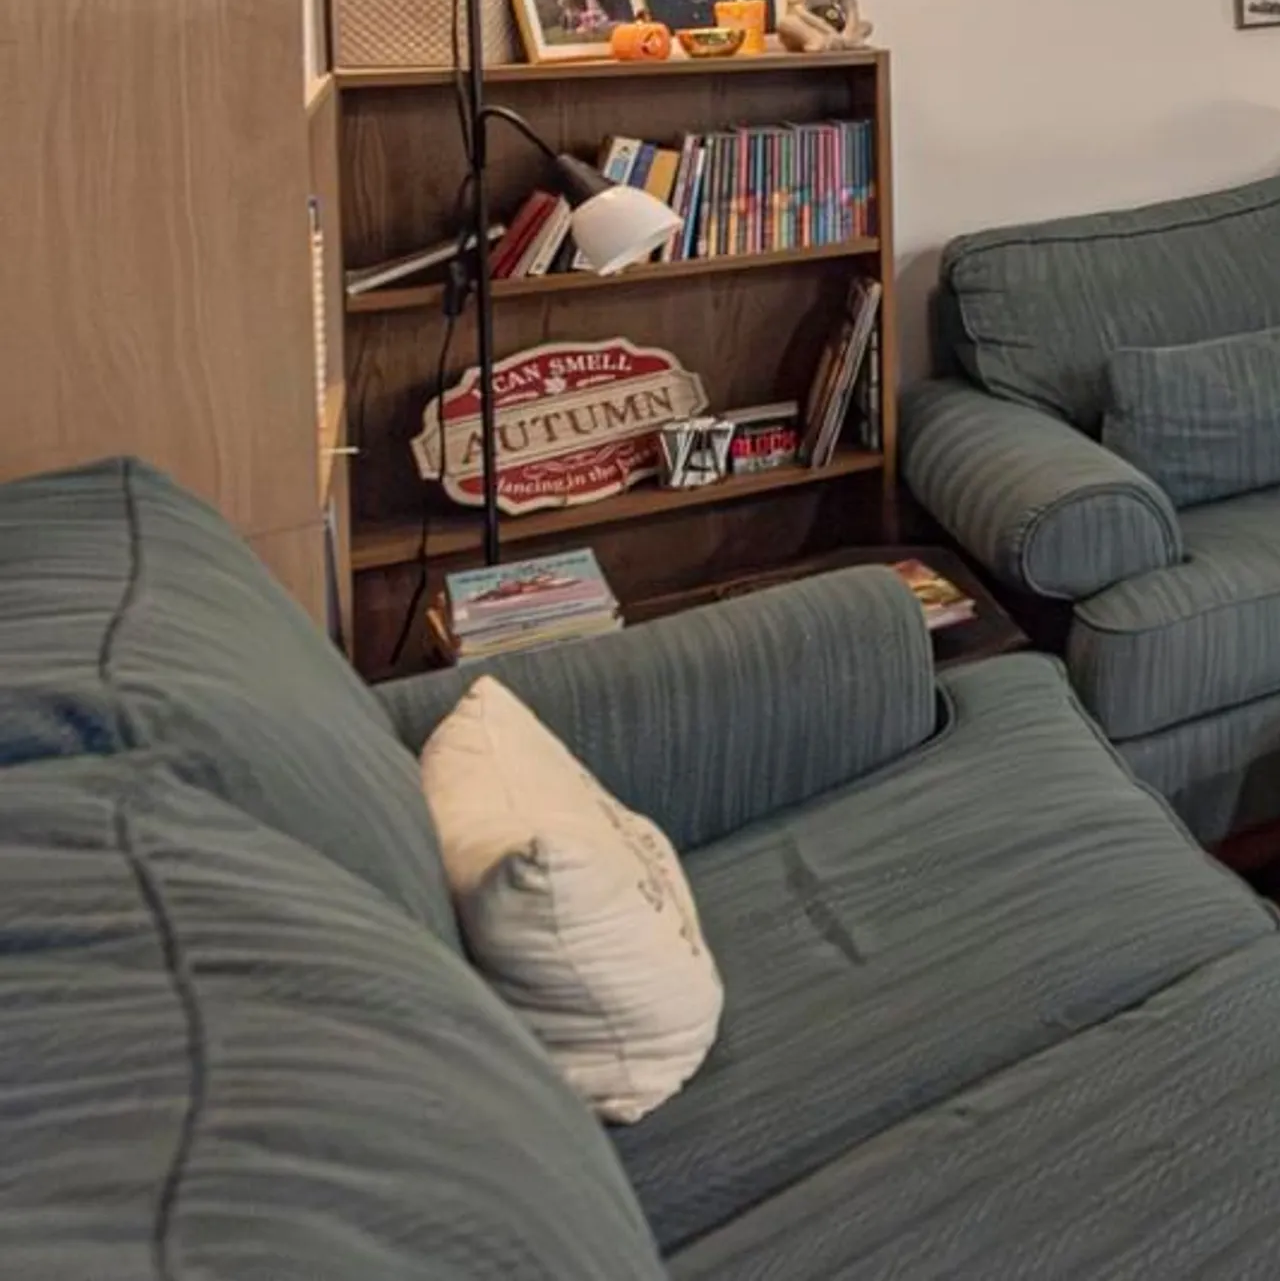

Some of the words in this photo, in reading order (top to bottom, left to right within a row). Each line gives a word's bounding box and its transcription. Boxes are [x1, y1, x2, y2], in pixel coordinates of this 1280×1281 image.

[492, 365, 539, 394] CAN
[547, 352, 633, 378] SMELL
[461, 386, 674, 465] AUTUMN
